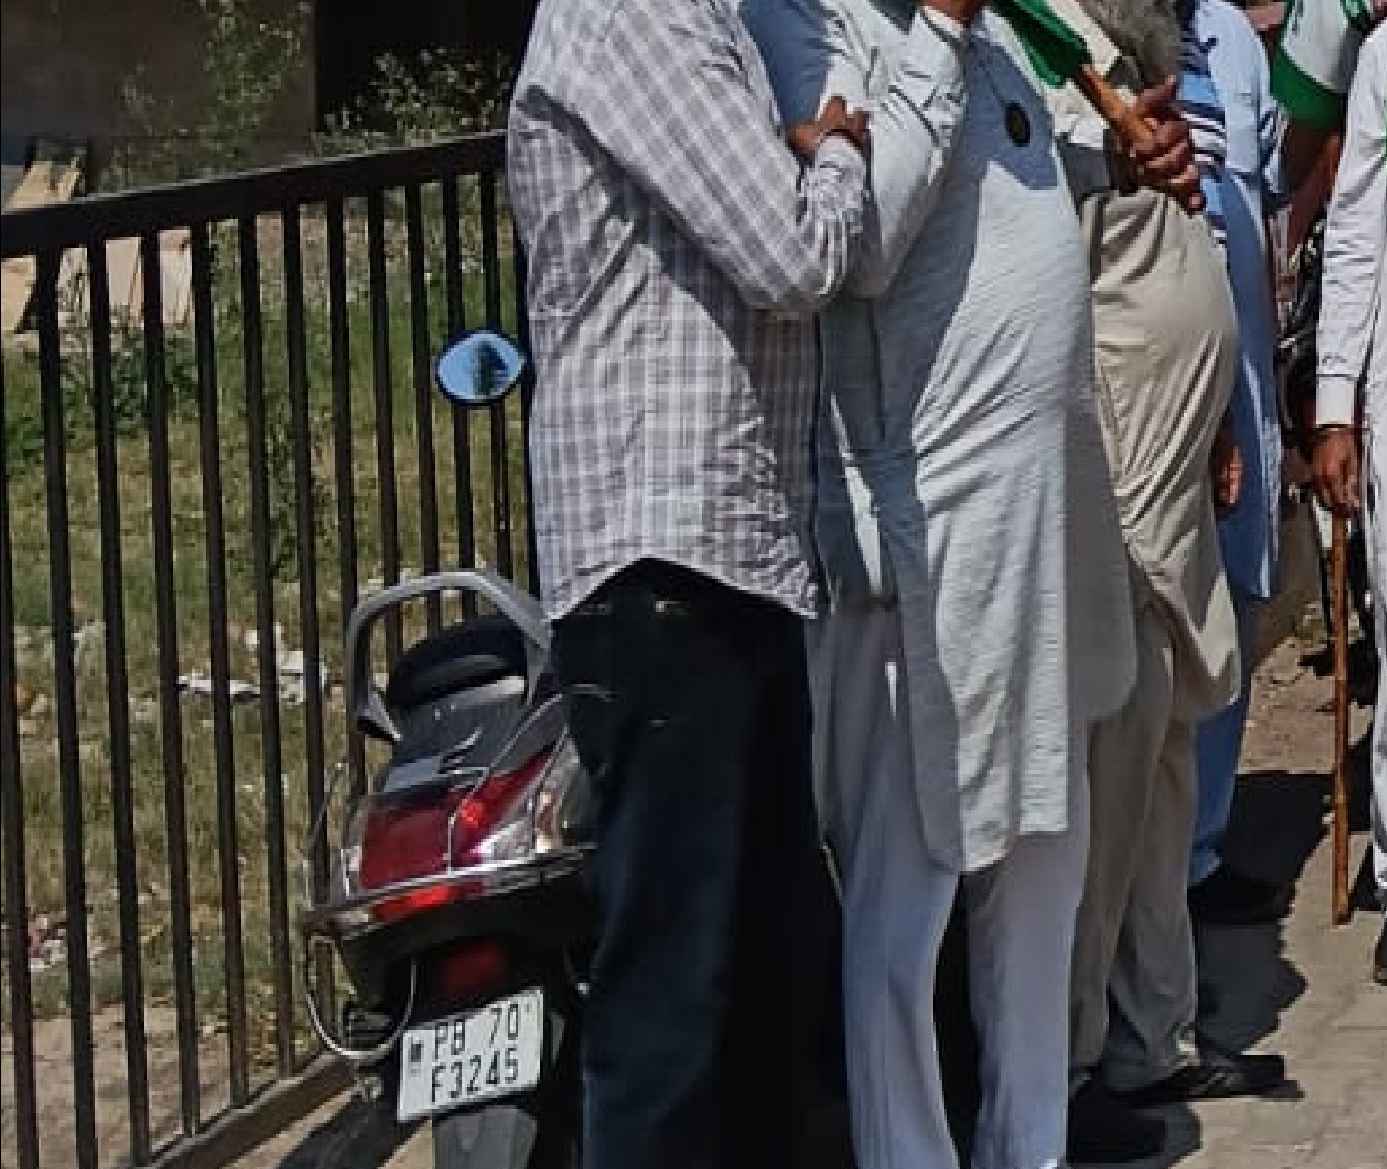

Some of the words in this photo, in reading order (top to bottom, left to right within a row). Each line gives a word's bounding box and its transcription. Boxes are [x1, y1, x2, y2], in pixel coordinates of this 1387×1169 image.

[434, 1017, 466, 1062] PB
[490, 1002, 519, 1047] 70
[431, 1047, 519, 1104] F3245
